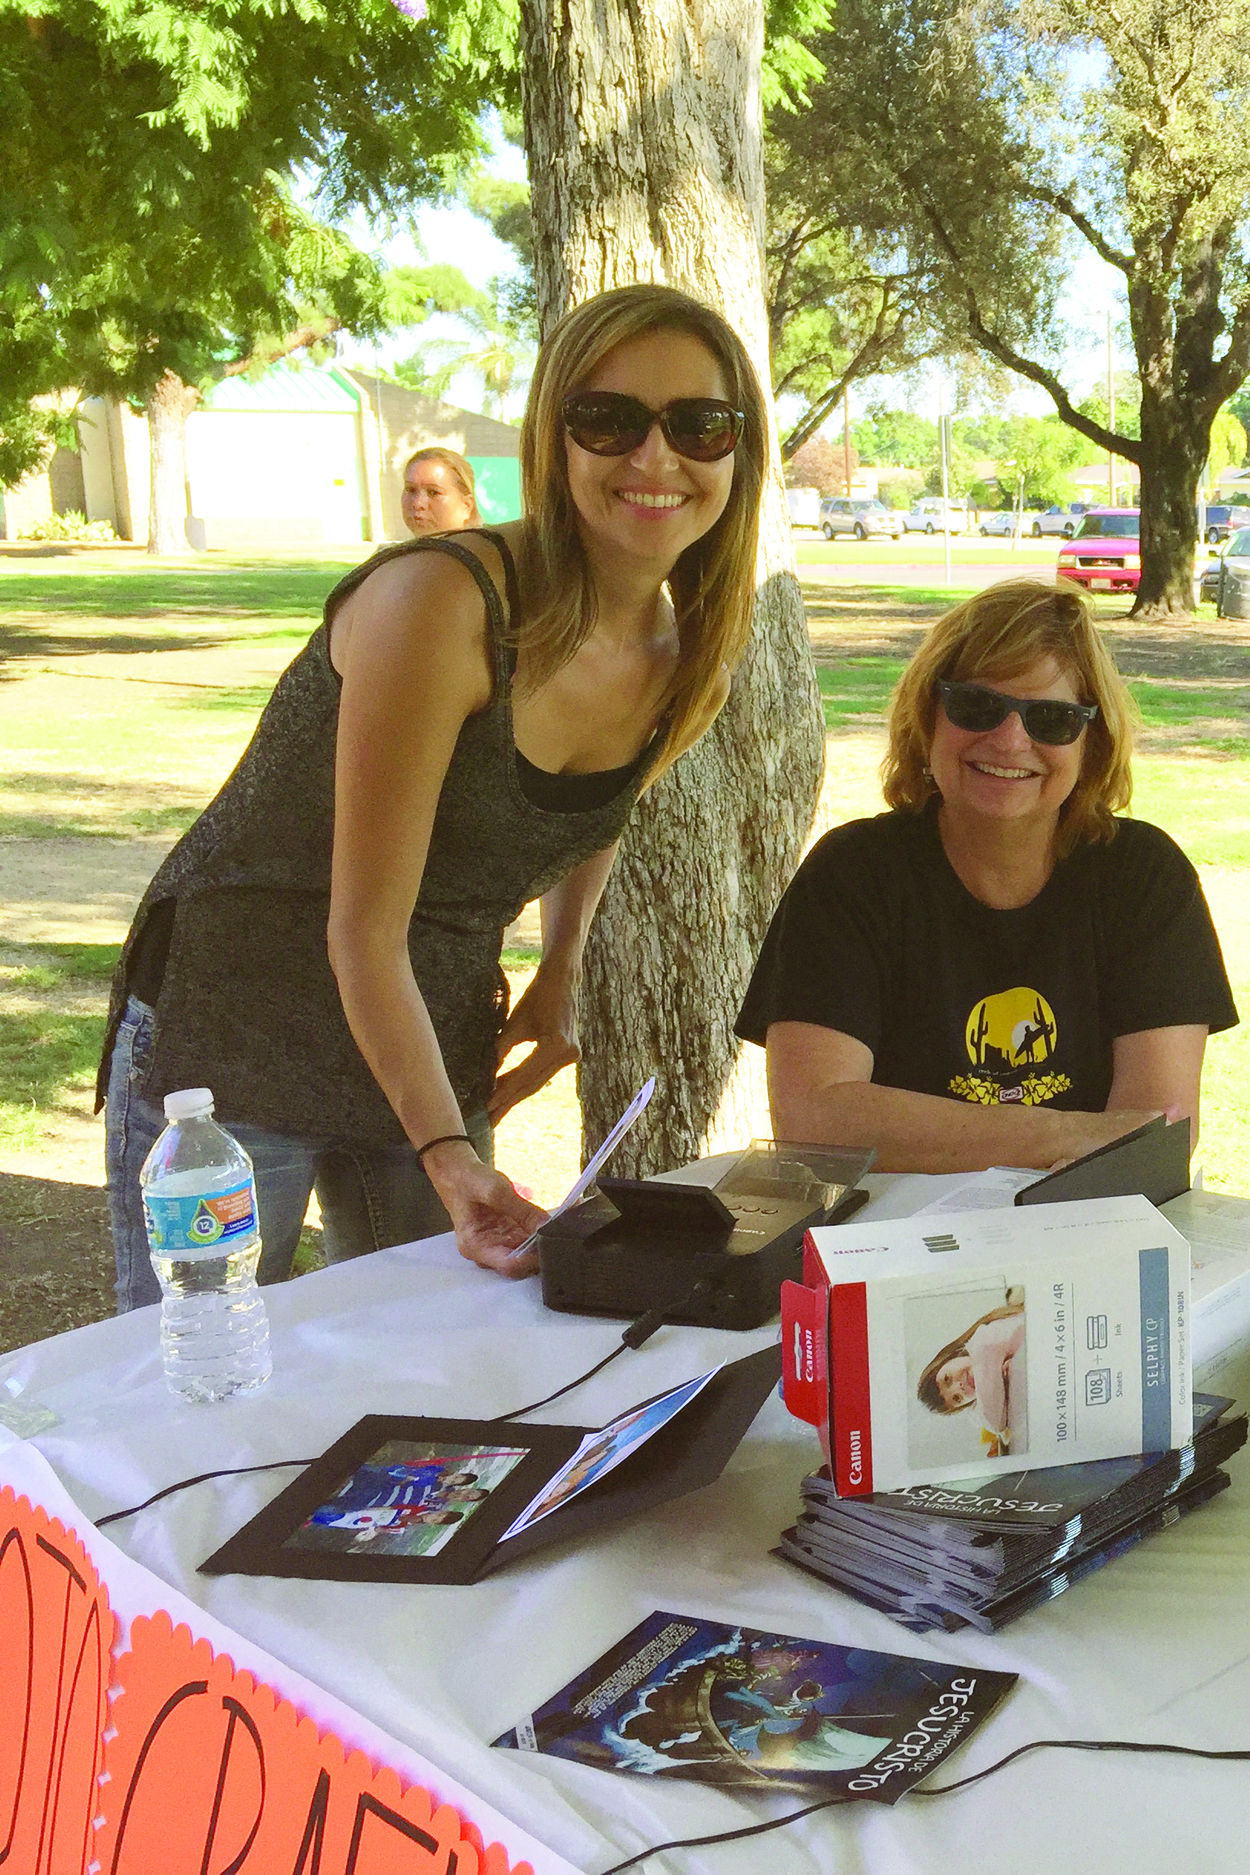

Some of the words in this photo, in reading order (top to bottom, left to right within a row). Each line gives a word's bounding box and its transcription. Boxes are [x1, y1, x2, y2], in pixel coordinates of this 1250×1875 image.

[1053, 1283, 1065, 1300] 4R
[1053, 1310, 1065, 1323] in
[1146, 1317, 1158, 1331] CP
[1054, 1323, 1065, 1333] 6
[1114, 1323, 1122, 1336] Ink
[1177, 1330, 1185, 1343] Set
[805, 1329, 814, 1383] Canon
[1054, 1344, 1066, 1354] 4
[1178, 1344, 1186, 1365] Paper
[1146, 1336, 1158, 1387] SELPHY
[1057, 1362, 1067, 1386] mm
[1090, 1379, 1103, 1401] 108
[1115, 1371, 1123, 1398] Sheets
[1055, 1389, 1067, 1410] 148
[1178, 1385, 1186, 1405] Color
[1056, 1422, 1067, 1442] 100
[849, 1430, 863, 1485] Canon
[887, 1487, 1065, 1513] JESUCRIST
[903, 1499, 922, 1507] DE
[923, 1500, 982, 1514] HISTORIA
[983, 1507, 1000, 1515] LA
[955, 1711, 975, 1724] LA
[848, 1678, 977, 1791] JESUCRISTO
[919, 1724, 963, 1762] HISTORIA
[908, 1762, 929, 1773] DE
